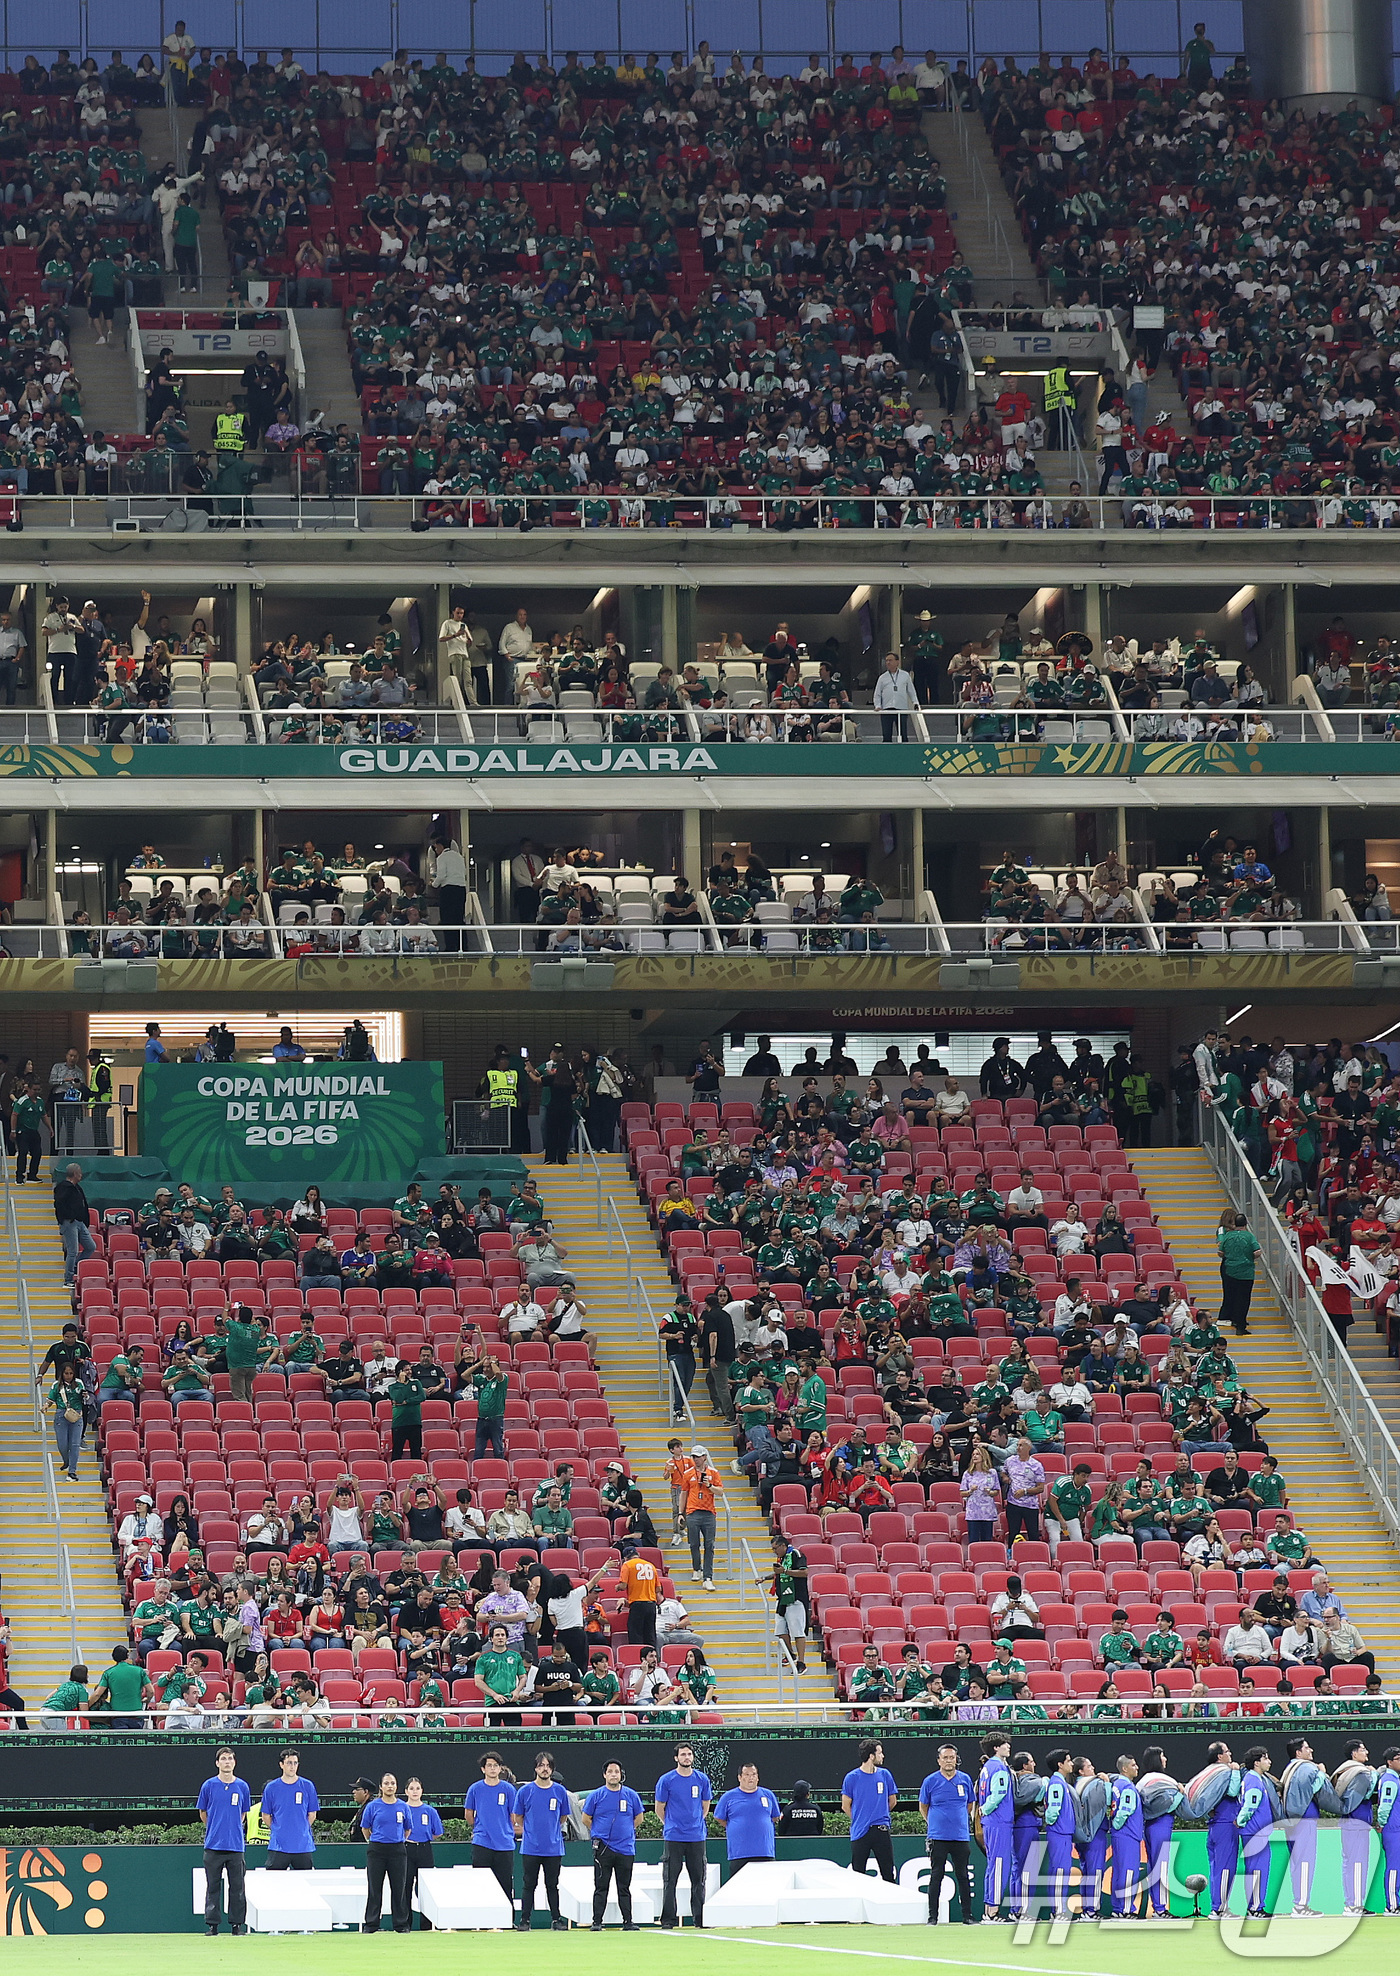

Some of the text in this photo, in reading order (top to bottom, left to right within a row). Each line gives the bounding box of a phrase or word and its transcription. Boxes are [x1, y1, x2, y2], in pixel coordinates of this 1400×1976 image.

[146, 334, 175, 347] 25
[192, 334, 232, 351] T2
[248, 335, 277, 347] 26
[968, 336, 997, 348] 26
[1013, 336, 1052, 353] T2
[1068, 336, 1096, 348] 27
[340, 747, 718, 773] GUADALAJARA
[832, 1006, 1015, 1017] COPA MUNDIAL DE LA FIFA 2026
[197, 1076, 391, 1097] COPA MUNDIAL
[226, 1100, 359, 1121] DE LA FIFA
[245, 1125, 338, 1146] 2026
[635, 1563, 654, 1581] 26
[547, 1672, 571, 1680] HUGO
